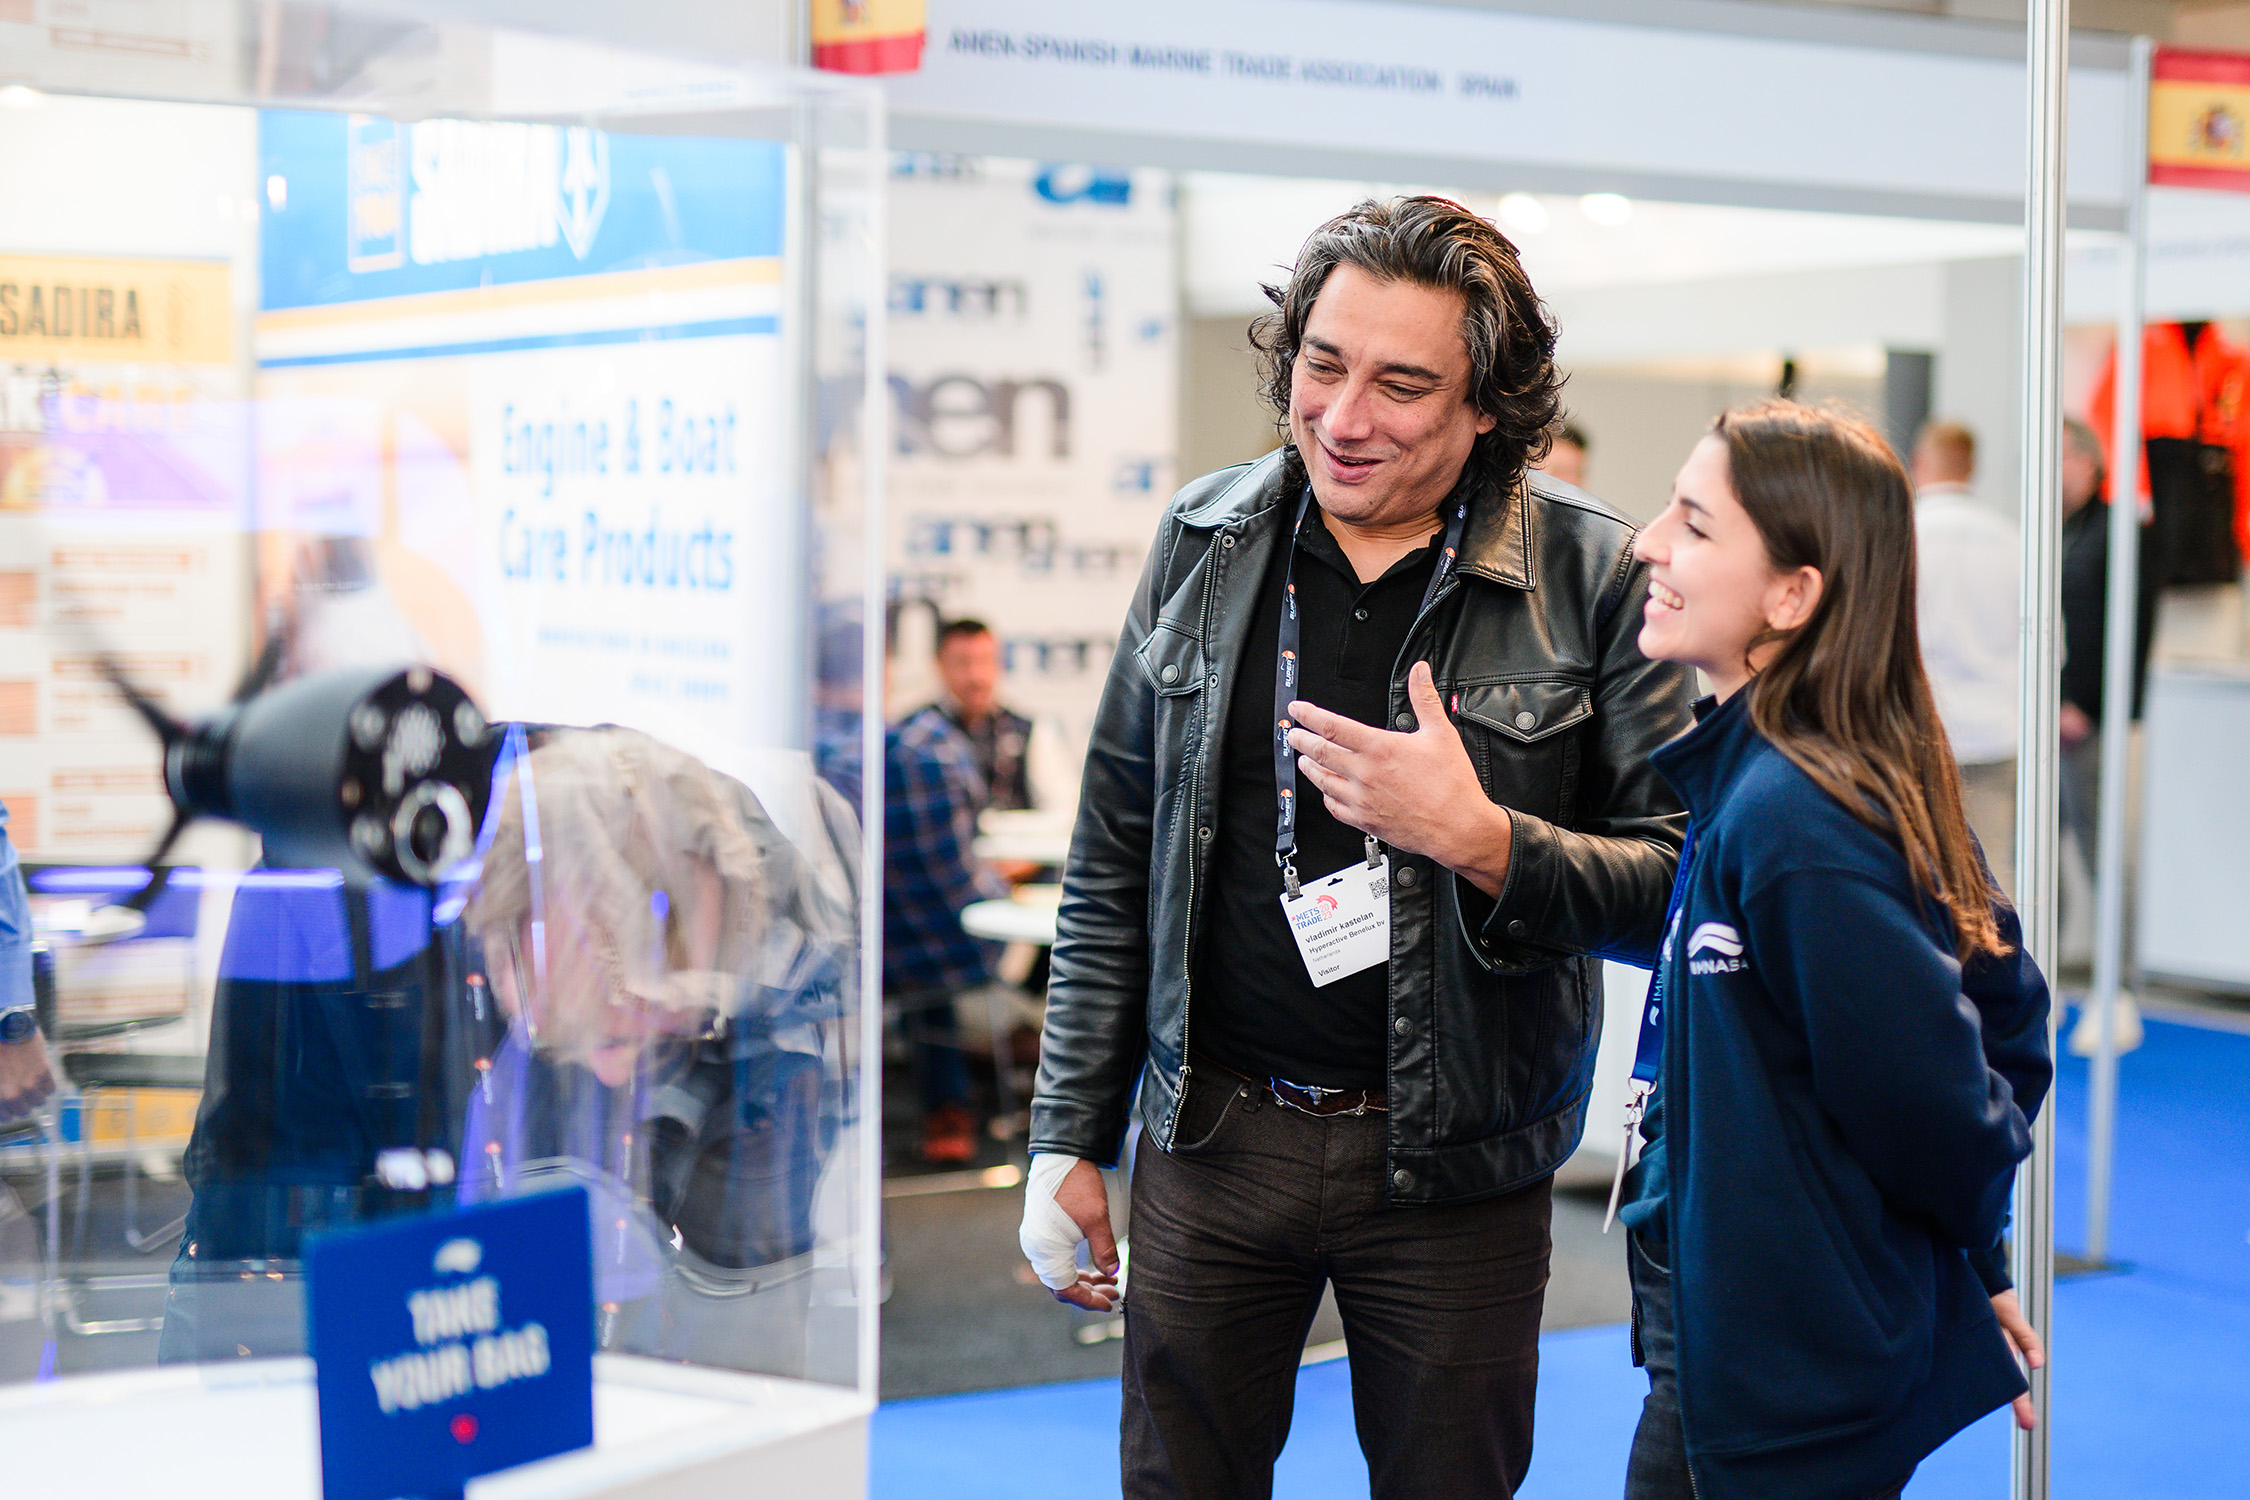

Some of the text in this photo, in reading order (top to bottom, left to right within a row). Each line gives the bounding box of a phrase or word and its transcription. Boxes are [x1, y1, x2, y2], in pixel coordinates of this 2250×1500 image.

[947, 28, 1117, 66] ANEN-SPANISH
[1126, 43, 1210, 76] MARINE
[1222, 51, 1291, 80] TRADE
[1299, 57, 1442, 93] ASSOCIATION
[0, 284, 143, 339] SADIRA
[502, 398, 736, 498] Engine & Boat
[501, 504, 733, 591] Care Products
[1284, 660, 1293, 687] SUPER
[1295, 903, 1330, 922] METS 20
[1296, 910, 1333, 930] TRADE 23
[1339, 911, 1374, 930] kastelan
[1308, 920, 1385, 954] Hyperactive Benelux bv
[1312, 949, 1341, 963] Netherlands
[1317, 964, 1341, 977] Visitor
[406, 1276, 501, 1346] TAKE
[370, 1343, 473, 1414] YOUR
